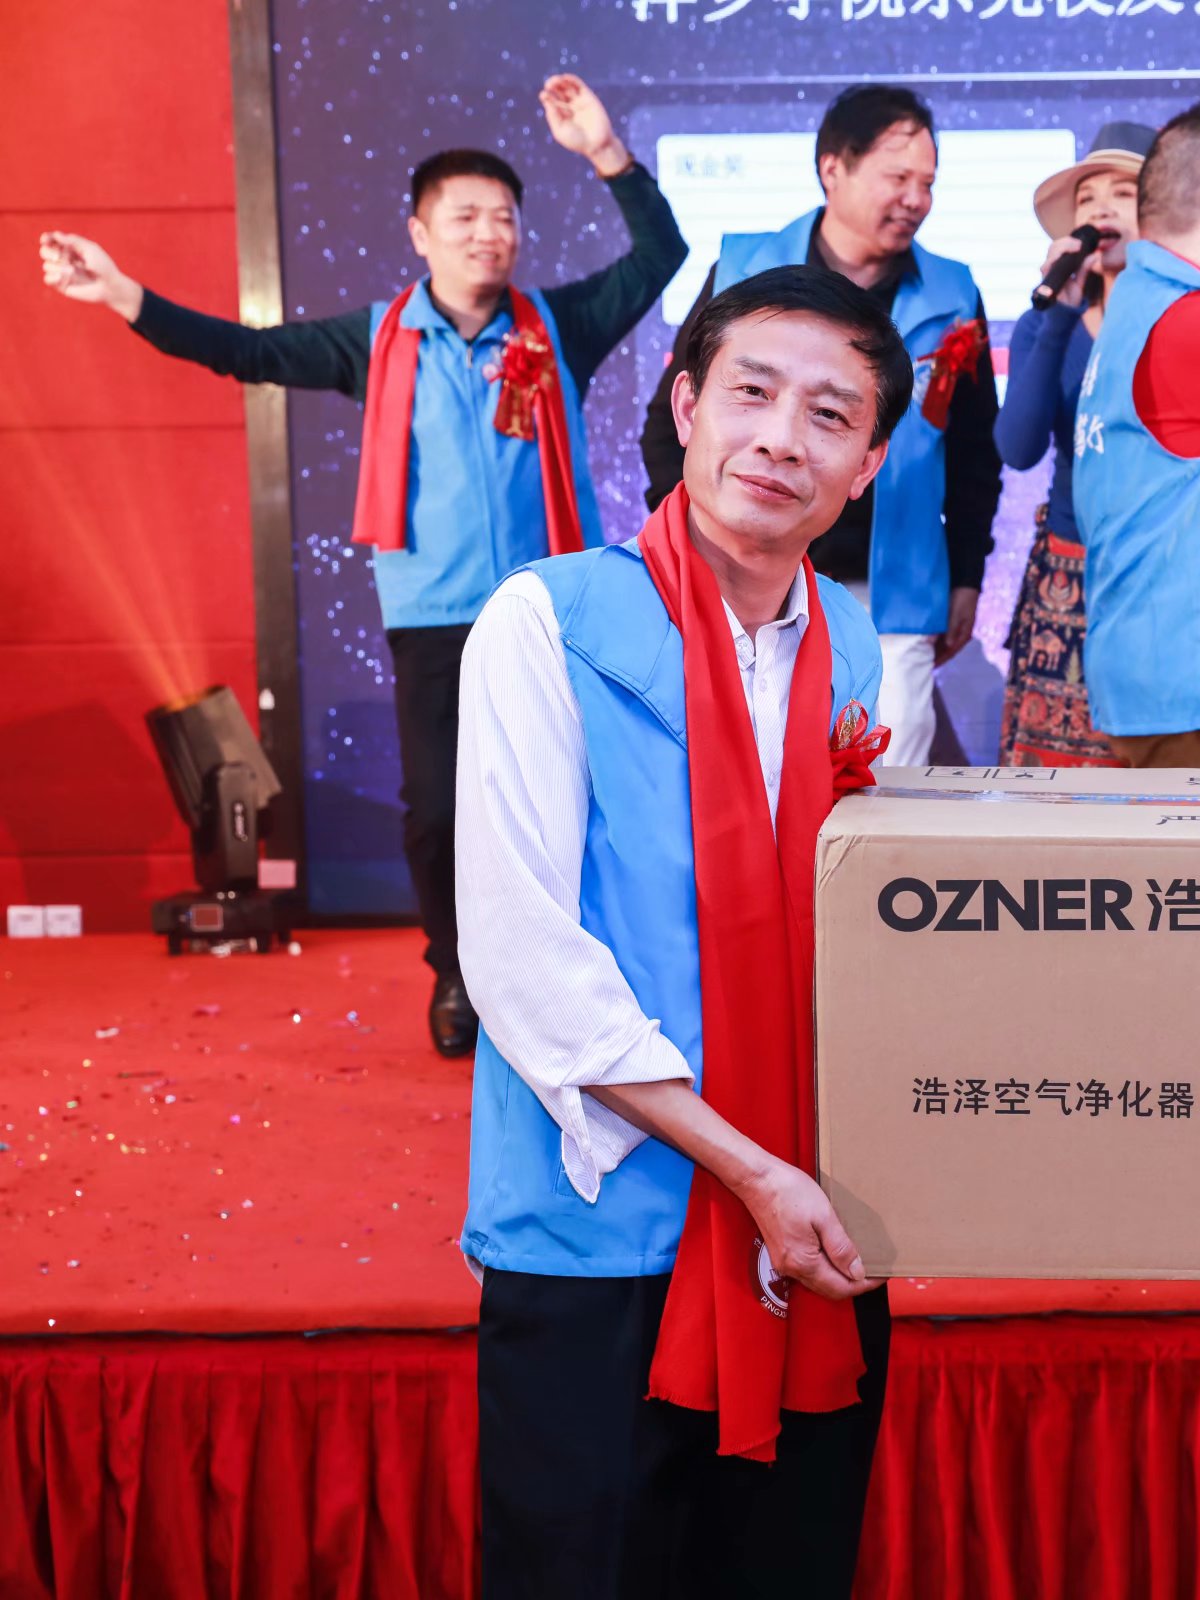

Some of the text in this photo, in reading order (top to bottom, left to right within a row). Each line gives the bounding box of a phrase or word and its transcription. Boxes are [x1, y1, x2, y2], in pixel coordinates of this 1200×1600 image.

[877, 876, 1135, 932] OZNER
[912, 1076, 1195, 1119] 浩泽空气净化器
